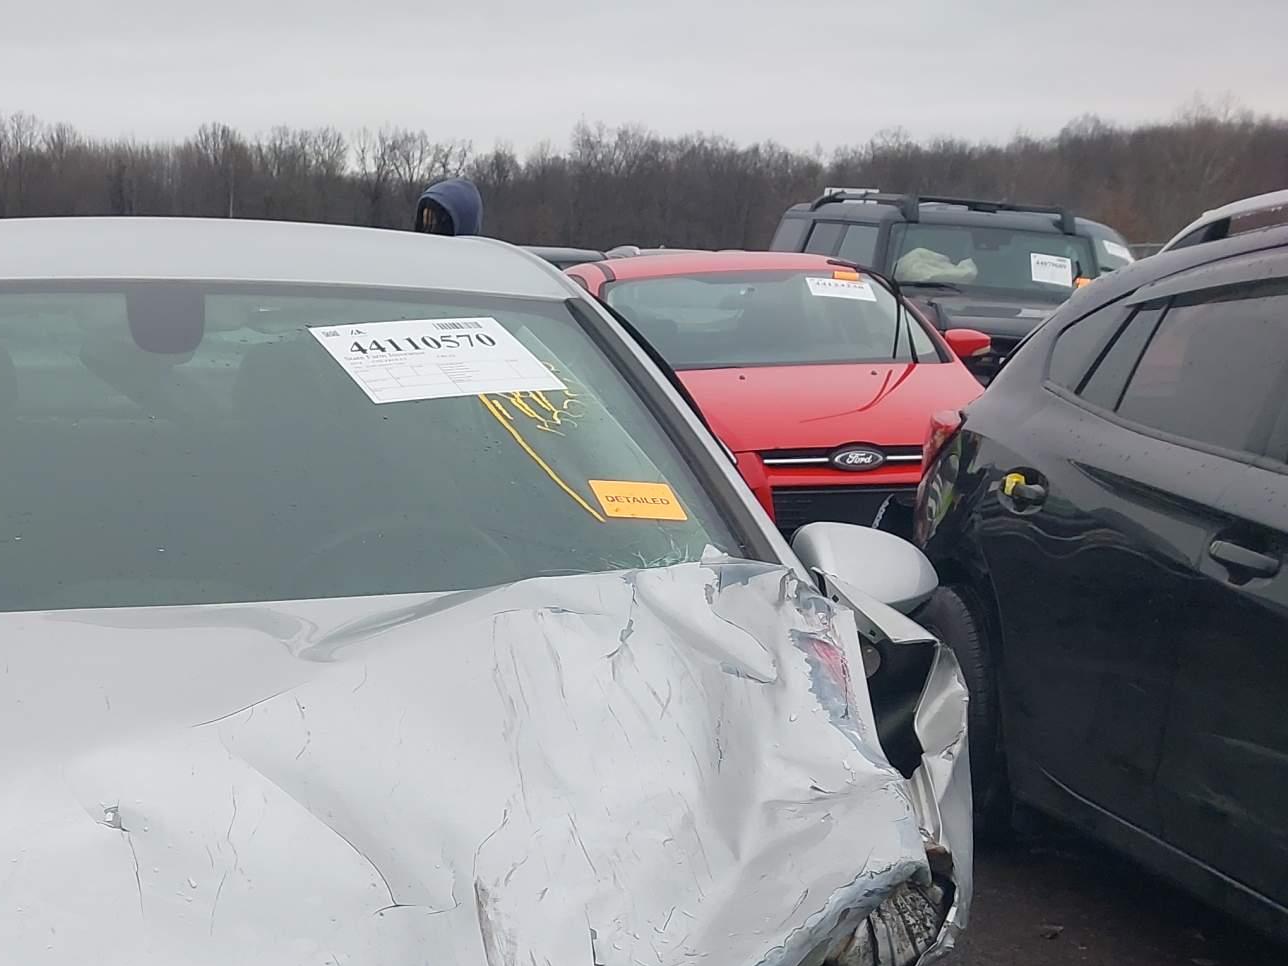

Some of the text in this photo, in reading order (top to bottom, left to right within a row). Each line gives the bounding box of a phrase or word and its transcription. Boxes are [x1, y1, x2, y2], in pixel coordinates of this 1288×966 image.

[349, 333, 497, 355] 44110570
[845, 452, 873, 465] Ford
[604, 495, 671, 506] DETAILED
